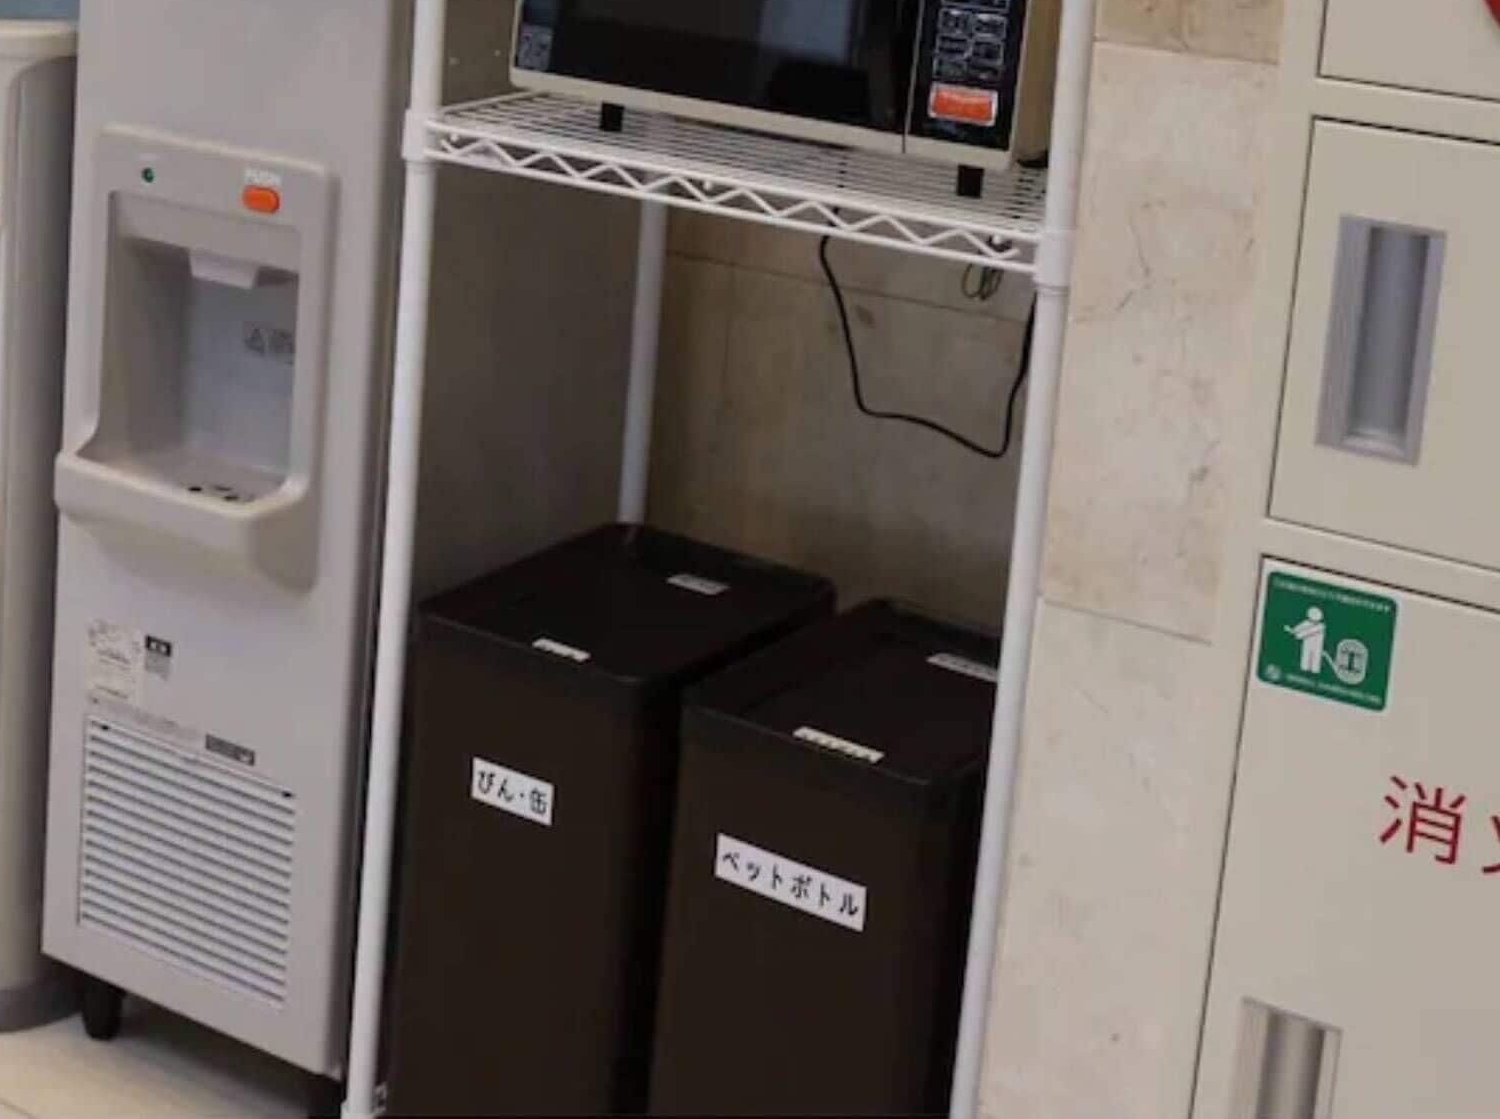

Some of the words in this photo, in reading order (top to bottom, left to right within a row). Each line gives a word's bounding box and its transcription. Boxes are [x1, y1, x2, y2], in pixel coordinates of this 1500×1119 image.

[476, 767, 550, 817] びん・缶
[1379, 776, 1500, 875] 消
[720, 848, 861, 918] ペットボトル
